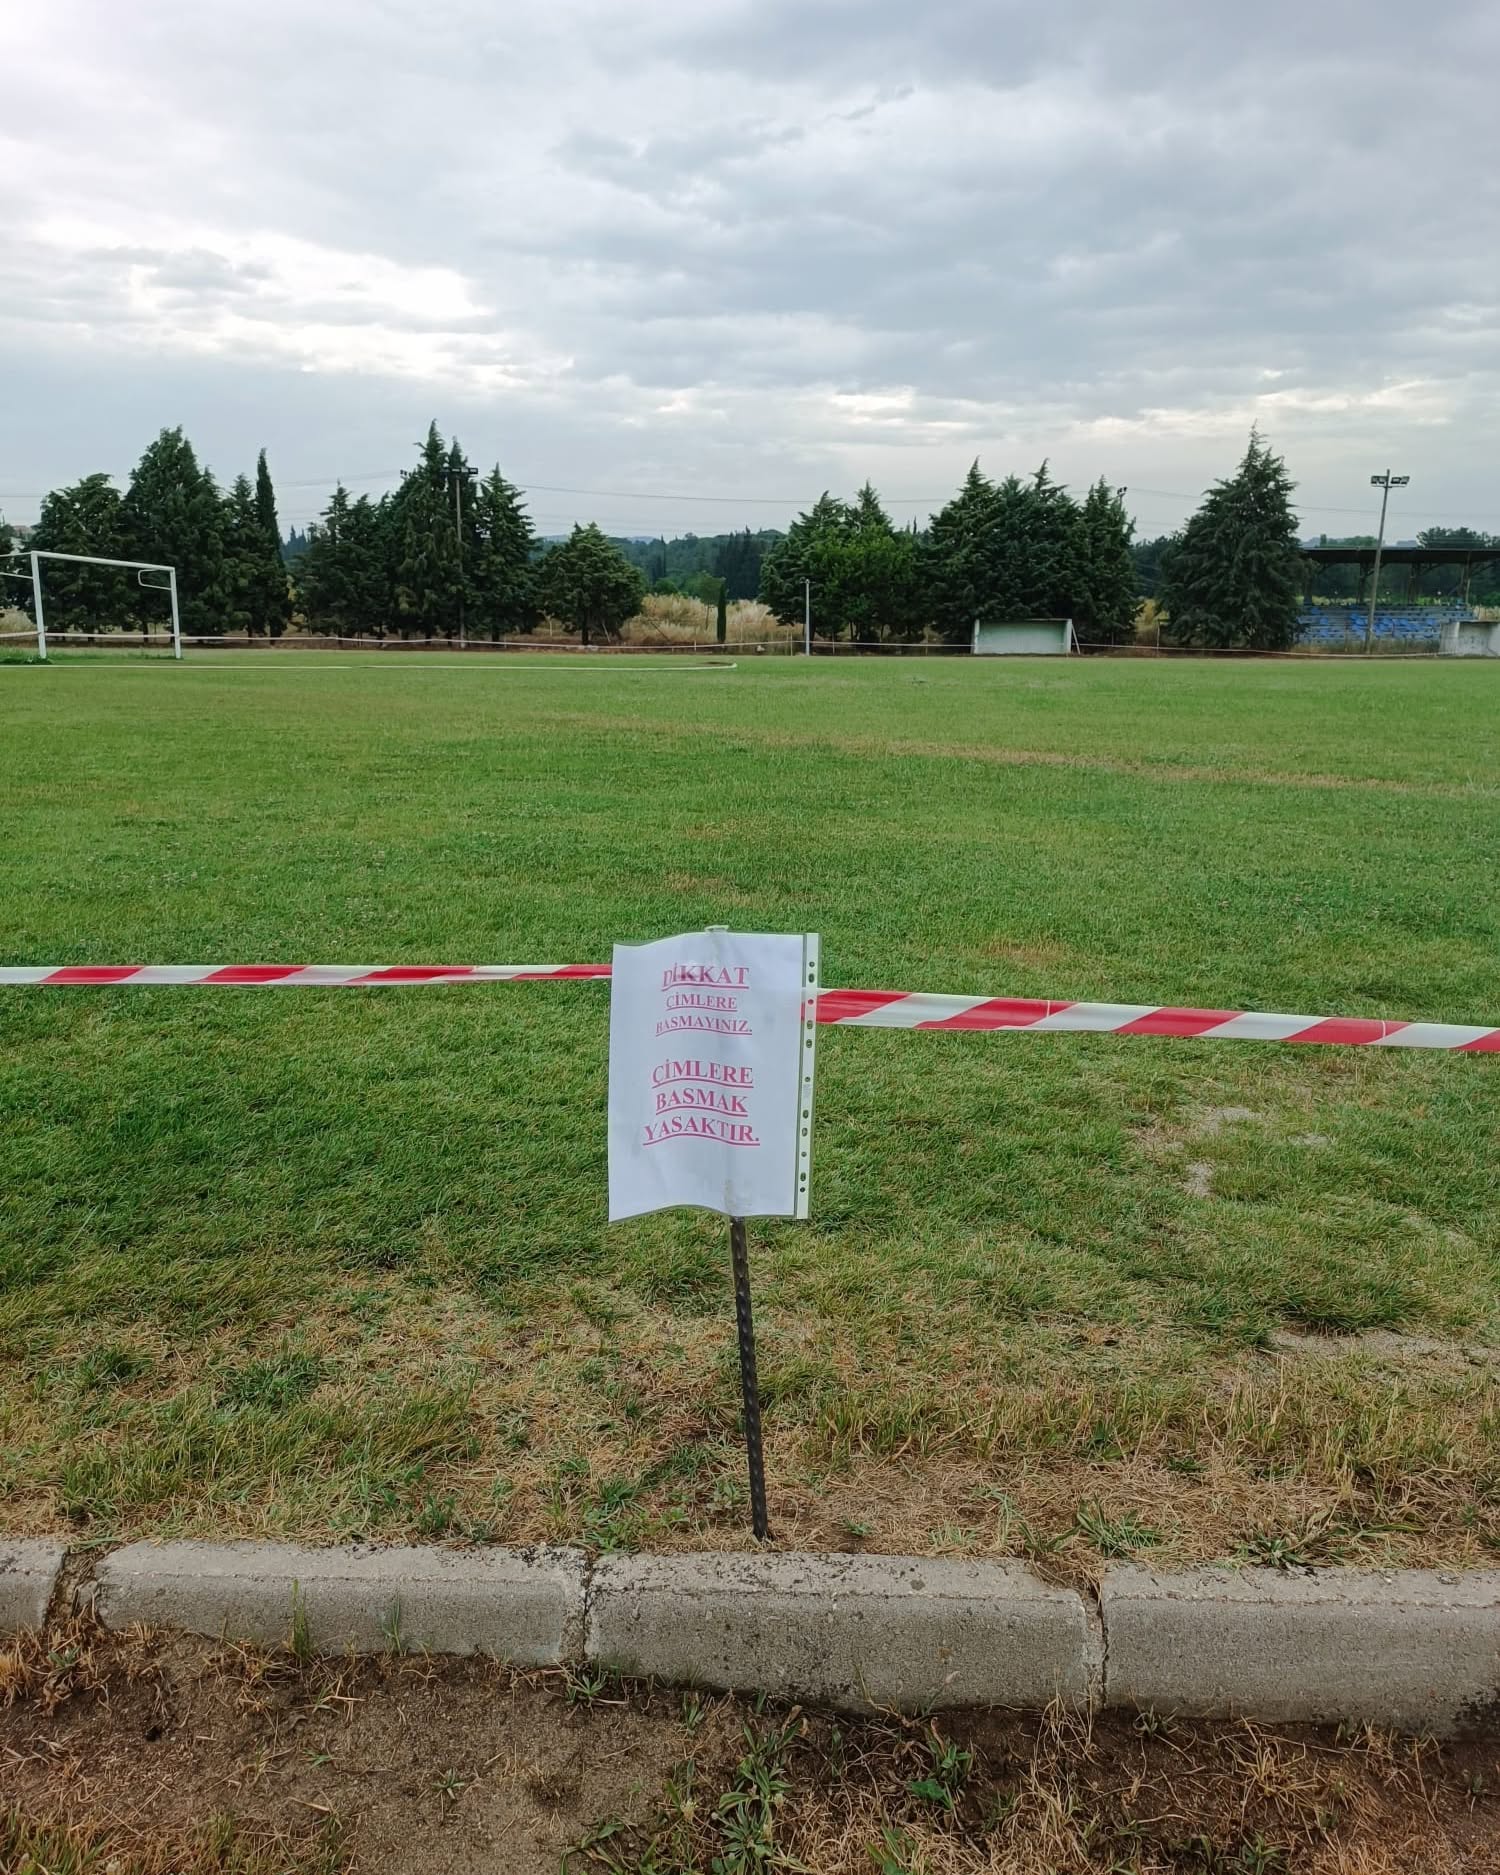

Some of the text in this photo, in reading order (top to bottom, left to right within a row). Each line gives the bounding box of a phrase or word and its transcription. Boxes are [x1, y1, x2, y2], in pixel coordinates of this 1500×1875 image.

[663, 962, 750, 988] DİKKAT
[666, 991, 737, 1009] ÇİMLERE
[656, 1015, 753, 1035] BASMAYINIZ.
[652, 1058, 754, 1085] ÇİMLERE
[656, 1087, 748, 1113] BASMAK
[644, 1115, 760, 1142] YASAKTIR.
